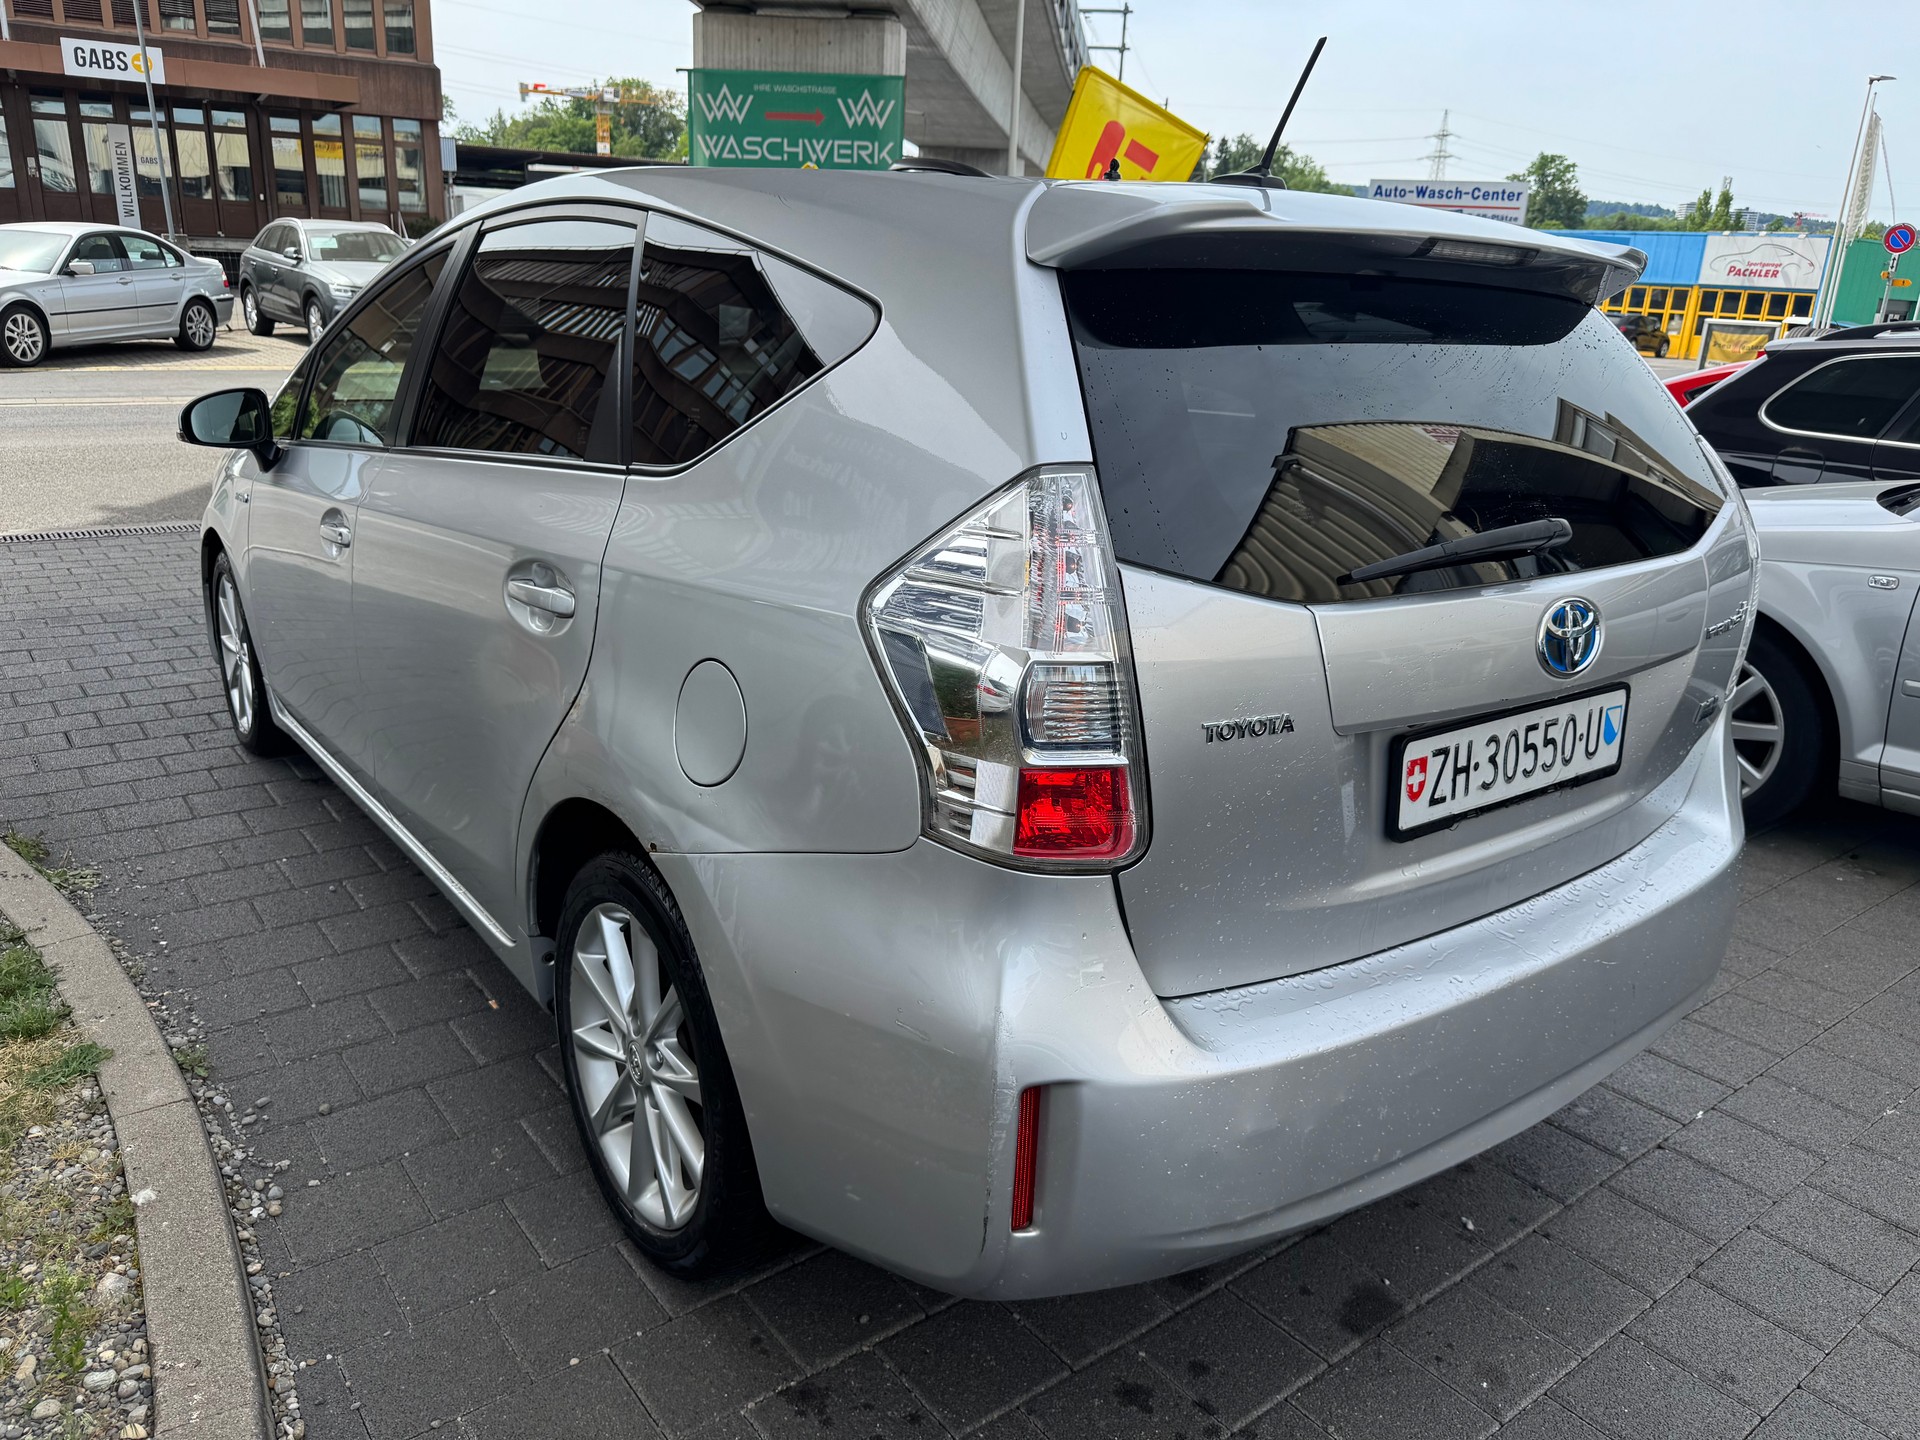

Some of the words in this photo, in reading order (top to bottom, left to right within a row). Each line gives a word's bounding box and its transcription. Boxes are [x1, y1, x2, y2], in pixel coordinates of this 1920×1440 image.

[73, 46, 129, 72] GABS
[753, 83, 771, 92] IHRE
[774, 84, 837, 95] WASCHSTRASSE
[696, 133, 895, 165] WASCHWERK
[140, 157, 158, 165] GABS
[114, 141, 135, 218] WILLKOMMEN
[1373, 184, 1523, 202] Auto-Wasch-Center
[1726, 265, 1780, 279] PACHLER
[1746, 260, 1784, 269] Sportgarage
[1201, 712, 1295, 744] TOYOTA
